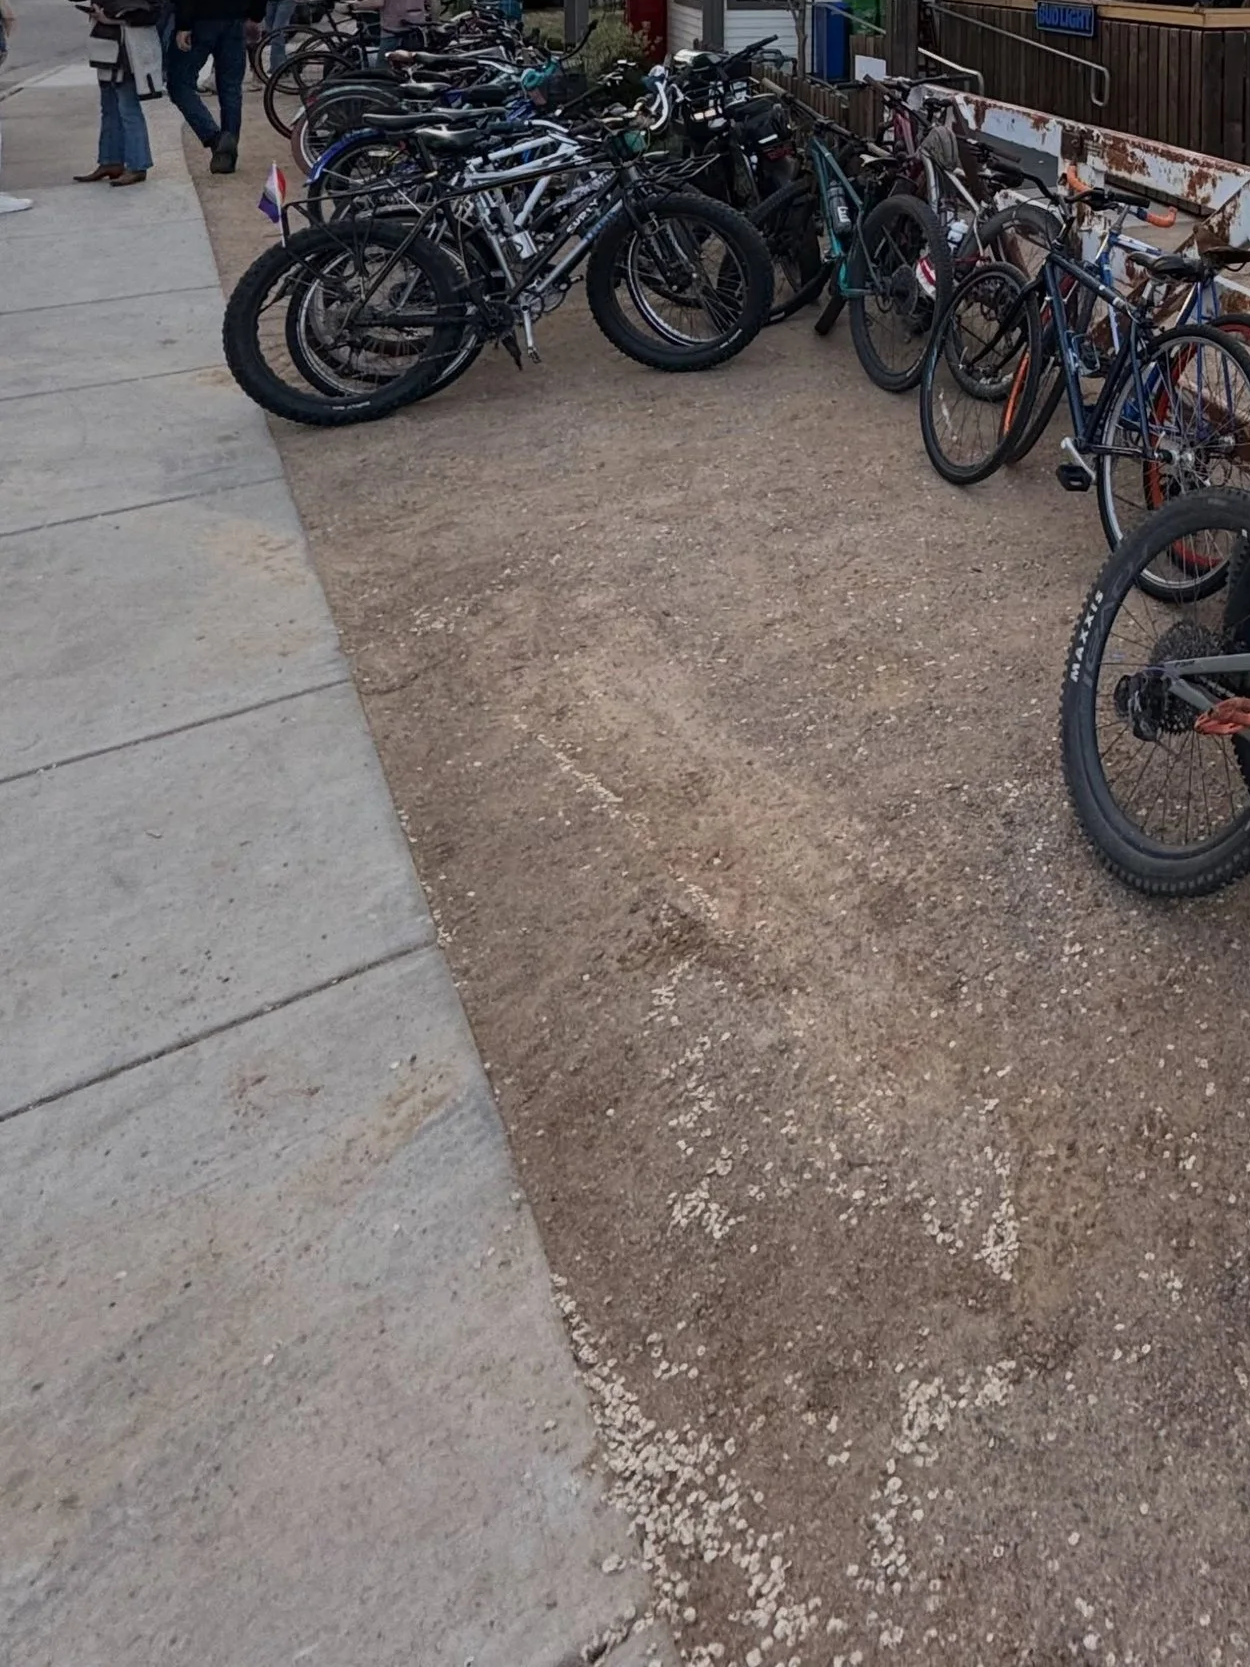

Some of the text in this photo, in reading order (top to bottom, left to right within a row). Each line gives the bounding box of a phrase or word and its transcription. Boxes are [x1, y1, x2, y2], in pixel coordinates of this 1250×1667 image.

[1039, 4, 1091, 31] BUD LIGHT
[1070, 590, 1104, 683] MAXXIS
